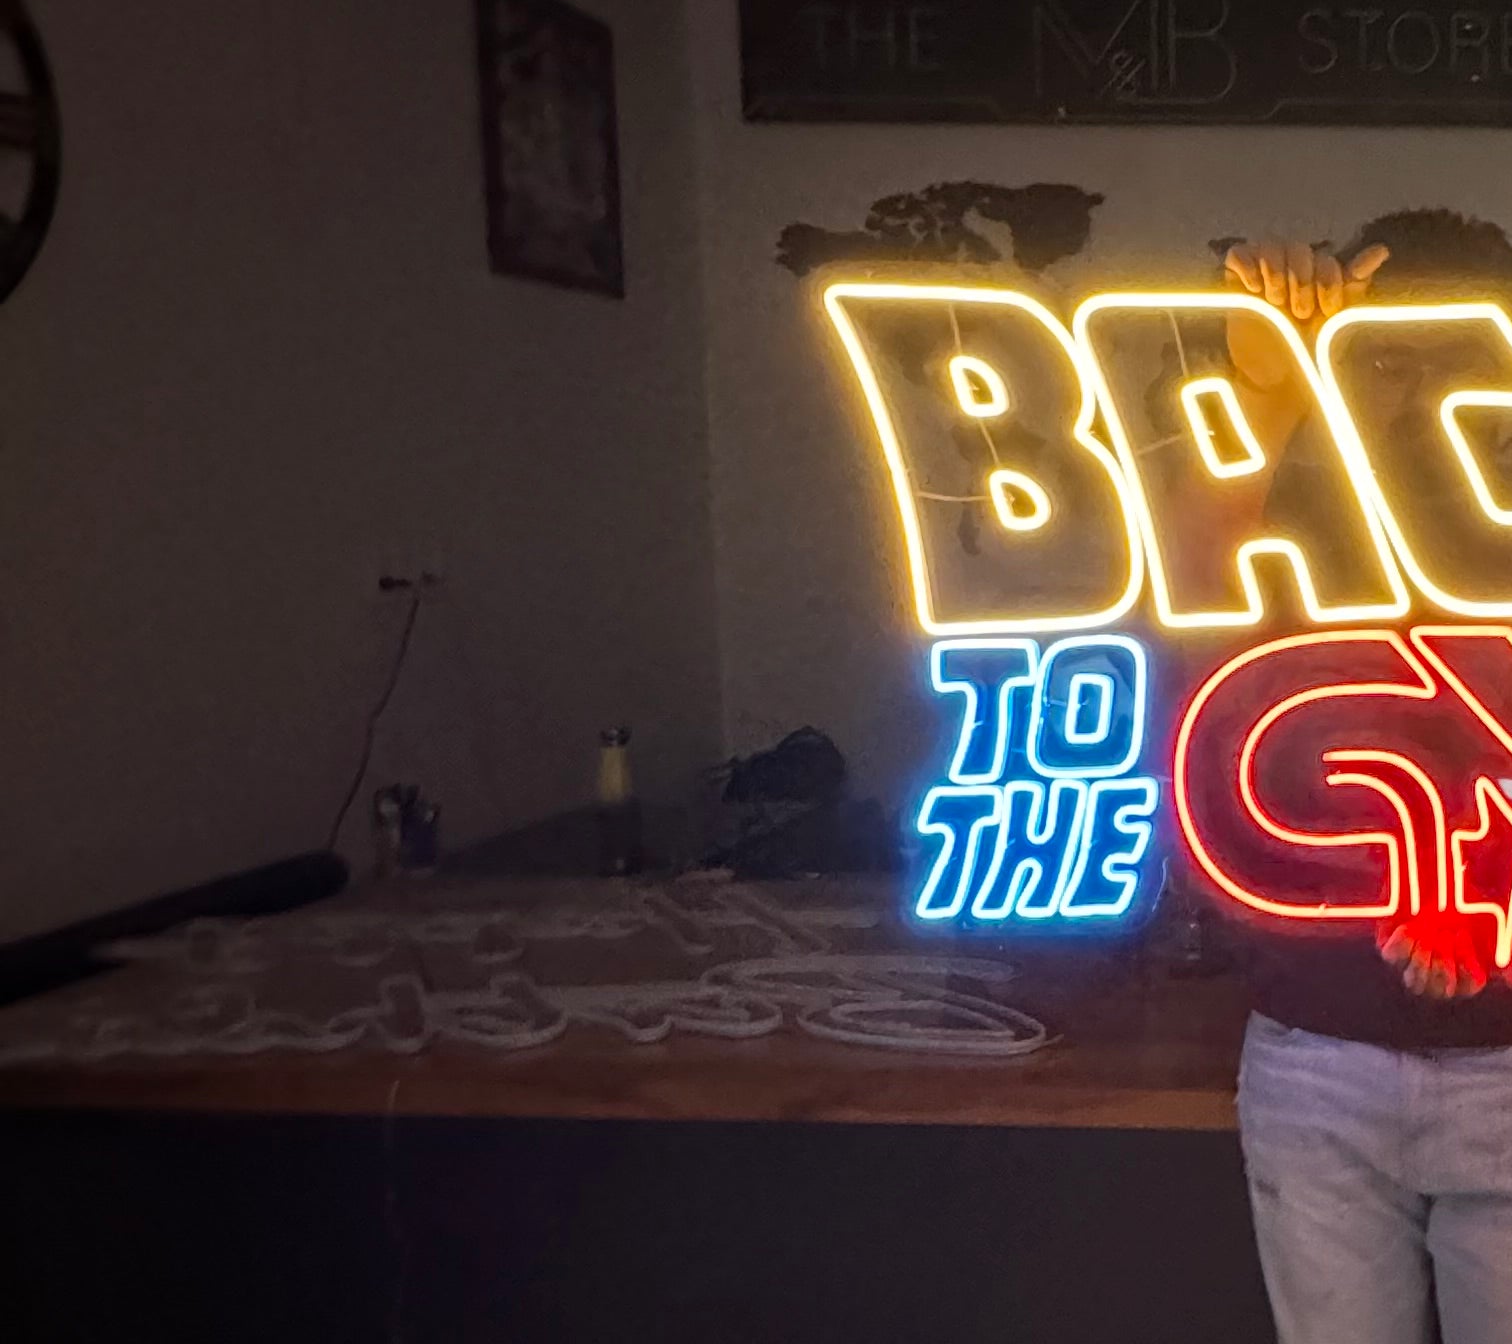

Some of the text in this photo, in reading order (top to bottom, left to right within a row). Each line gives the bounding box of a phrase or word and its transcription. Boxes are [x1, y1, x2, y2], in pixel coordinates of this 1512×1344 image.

[799, 0, 946, 72] THE
[930, 633, 1147, 785] TO
[915, 777, 1159, 919] THE
